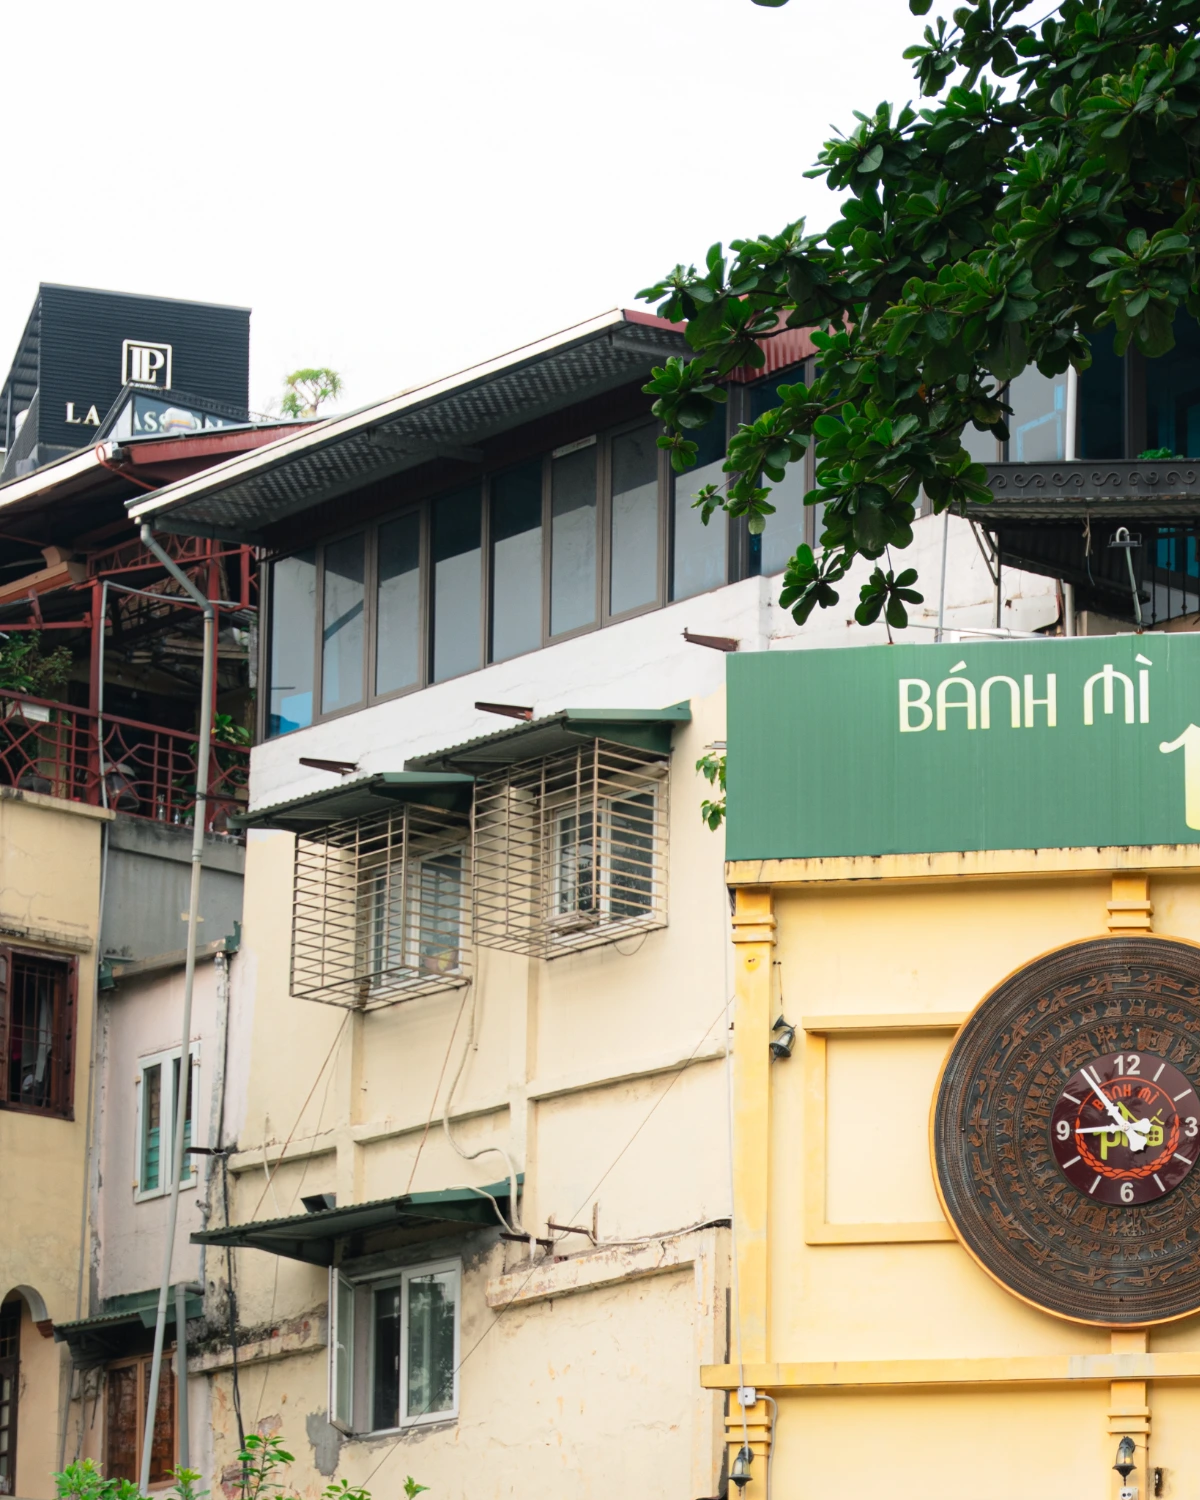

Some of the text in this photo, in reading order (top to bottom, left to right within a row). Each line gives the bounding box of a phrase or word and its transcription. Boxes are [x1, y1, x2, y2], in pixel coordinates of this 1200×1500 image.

[65, 402, 101, 426] LA
[899, 653, 1150, 733] BÁNH MÌ
[1113, 1054, 1141, 1076] 12
[1056, 1120, 1071, 1141] 9
[1184, 1116, 1199, 1137] 3
[1120, 1182, 1134, 1203] 6
